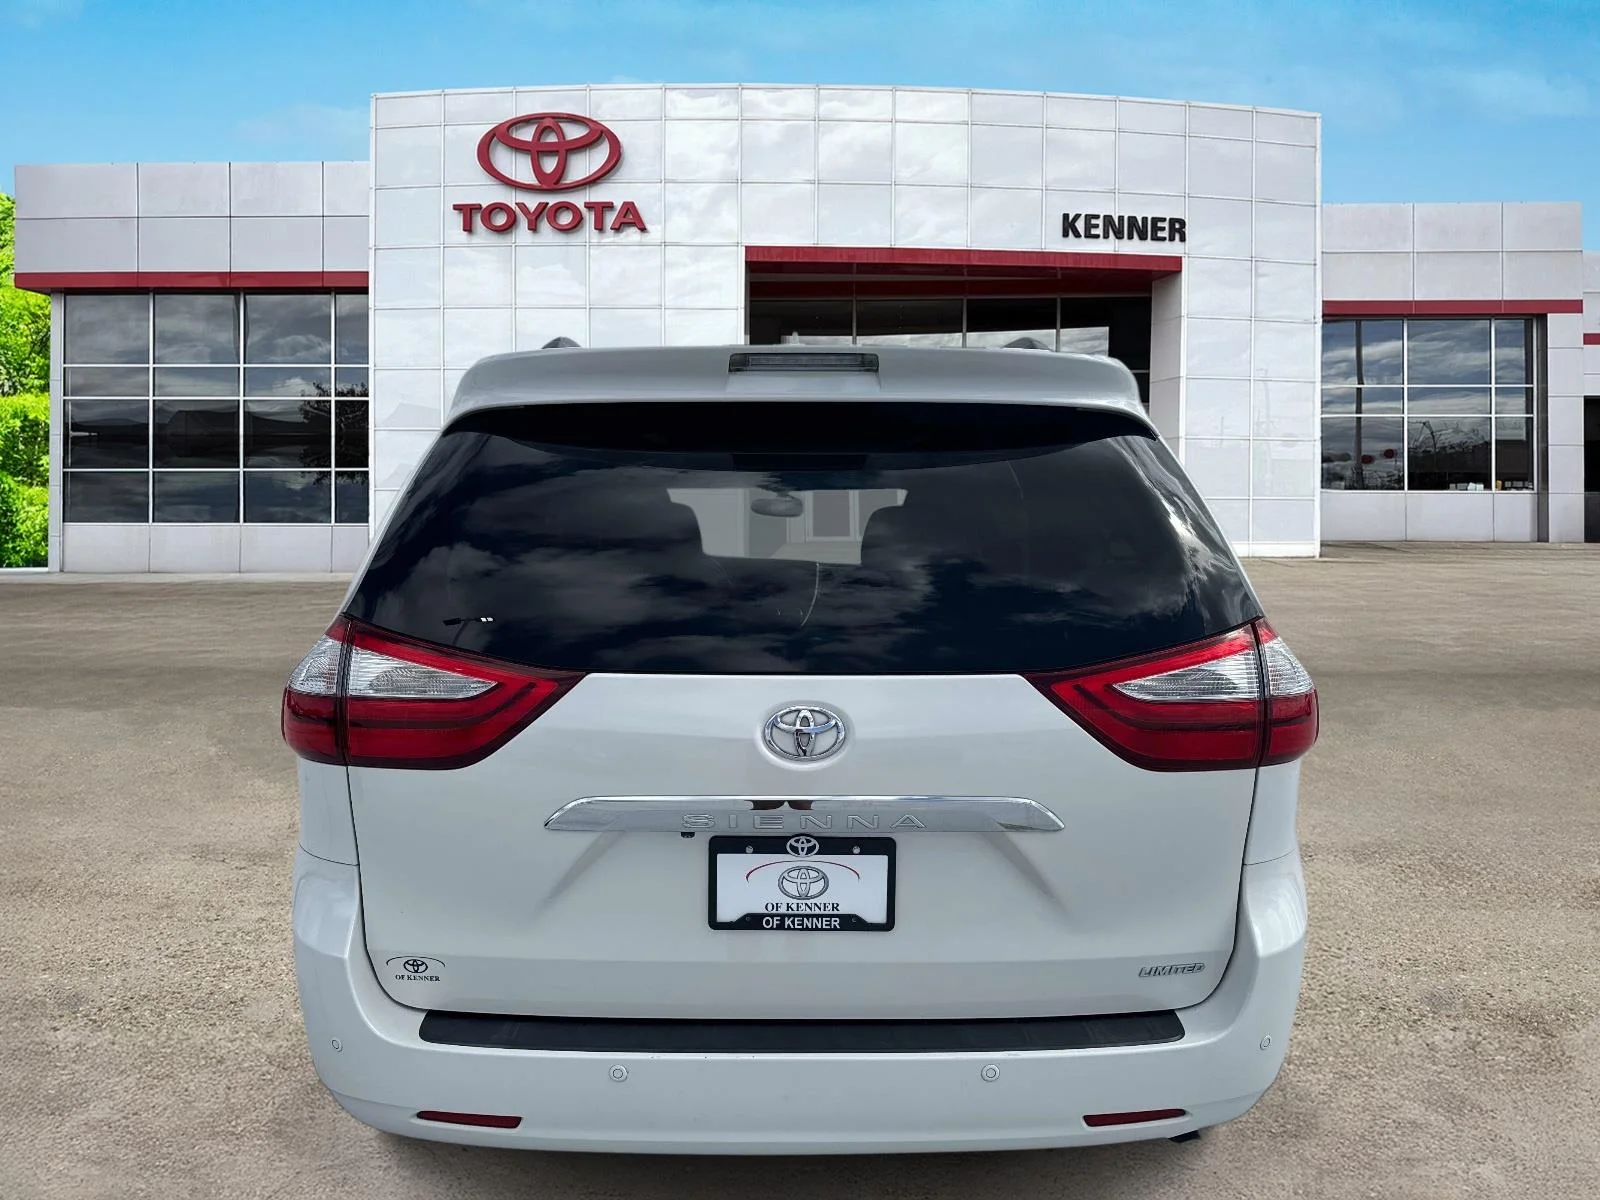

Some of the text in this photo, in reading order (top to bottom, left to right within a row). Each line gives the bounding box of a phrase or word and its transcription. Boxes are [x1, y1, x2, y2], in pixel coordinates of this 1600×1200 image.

[452, 201, 647, 232] TOYOTA
[1062, 213, 1187, 243] KENNER
[681, 813, 927, 830] SIENNA
[764, 902, 840, 912] OF KENNER
[762, 916, 841, 929] OF KENNER
[407, 974, 441, 982] KENNER
[1138, 962, 1206, 978] LIMITED
